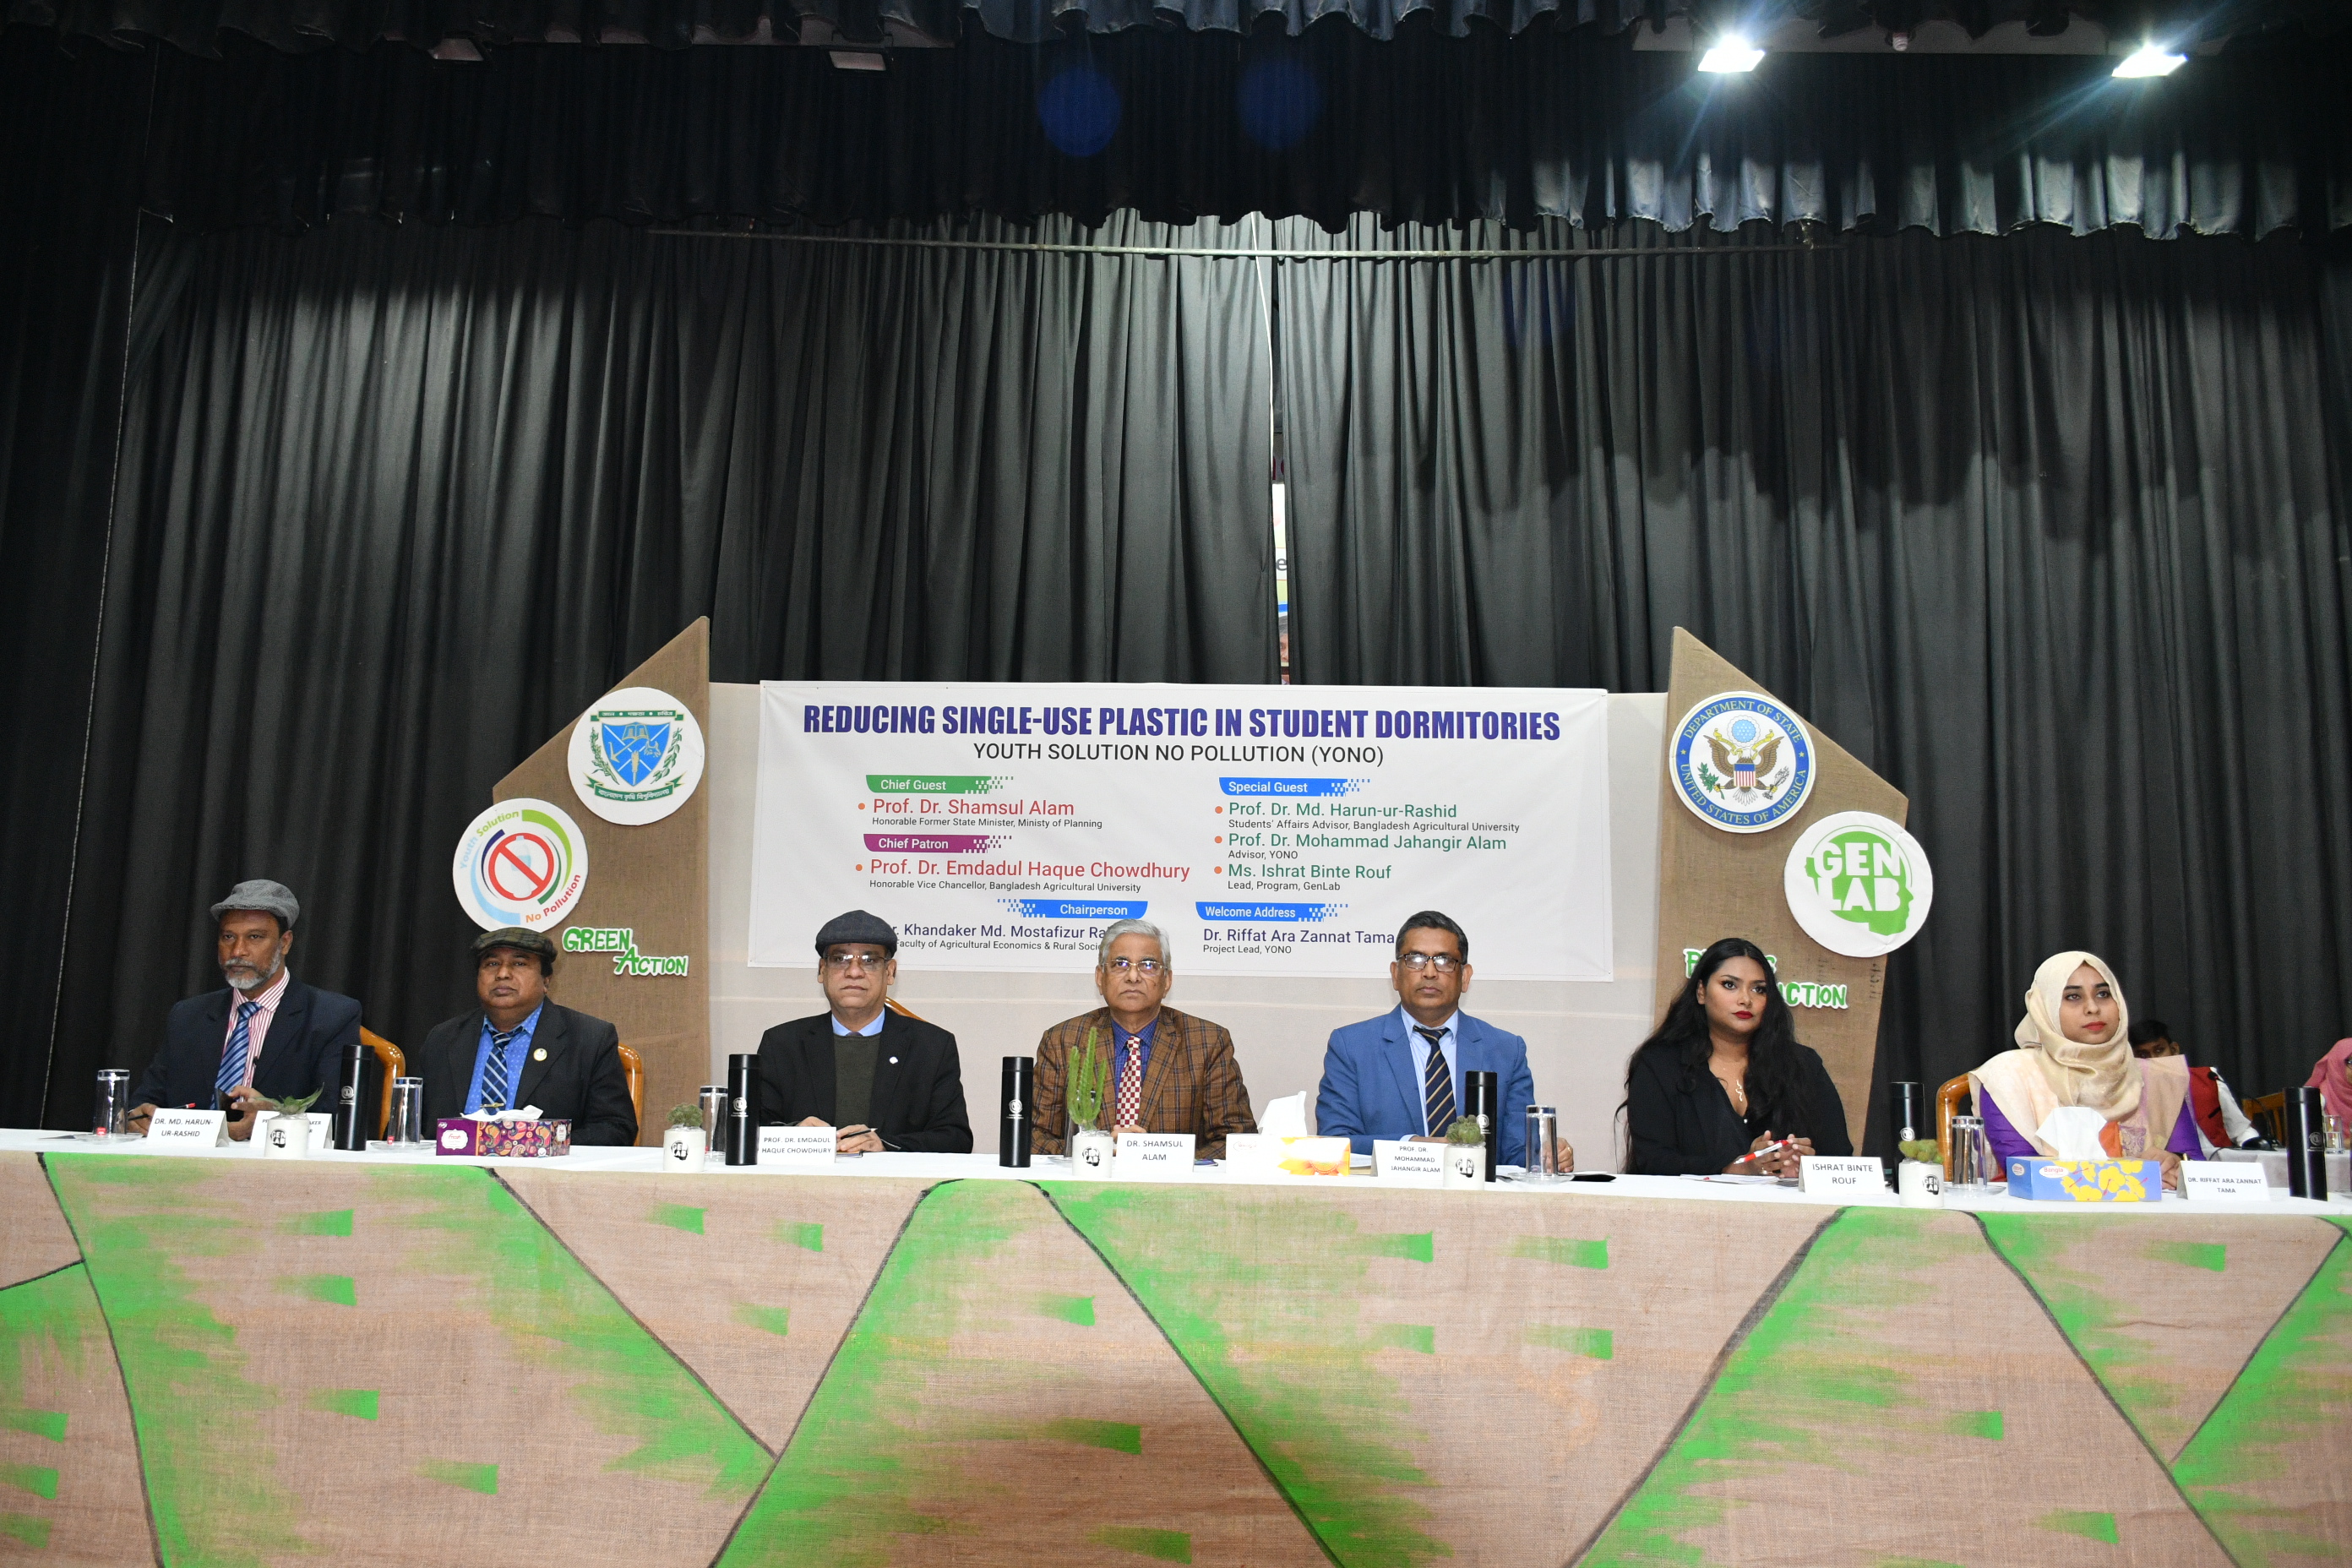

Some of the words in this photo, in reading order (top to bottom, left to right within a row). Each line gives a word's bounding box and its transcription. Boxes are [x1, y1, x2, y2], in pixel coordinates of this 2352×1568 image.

[804, 705, 935, 733] REDUCING
[942, 706, 1092, 735] SINGLE-USE
[1099, 707, 1207, 737] PLASTIC
[1215, 709, 1242, 737] IN
[1250, 709, 1368, 738] STUDENT
[1375, 710, 1560, 740] DORMITORIES
[1684, 700, 1755, 739] DEPARTMENT
[1757, 702, 1772, 716] OF
[1773, 710, 1804, 743] STATE
[973, 743, 1041, 759] YOUTH
[1048, 743, 1148, 760] SOLUTION
[1156, 745, 1184, 761] NO
[1191, 745, 1304, 762] POLLUTION
[1311, 745, 1384, 767] (YONO)
[880, 779, 911, 790] Chief
[913, 780, 946, 791] Guest
[1228, 781, 1271, 794] Special
[1273, 782, 1308, 792] Guest
[1680, 764, 1707, 811] UNITED
[1706, 803, 1750, 825] STATES
[1753, 811, 1769, 824] OF
[1772, 769, 1807, 819] AMERICA
[873, 798, 913, 814] Prof.
[920, 799, 941, 814] Dr.
[948, 799, 1023, 815] Shamsul
[1029, 800, 1074, 815] Alam
[1229, 802, 1265, 815] Prof.
[1271, 803, 1290, 815] Dr.
[1296, 803, 1324, 816] Md.
[1331, 803, 1457, 818] Harun-ur-Rashid
[872, 817, 917, 825] Honorable
[919, 818, 950, 826] Former
[953, 818, 976, 826] State
[978, 818, 1015, 828] Minister,
[1018, 818, 1049, 829] Ministy
[1052, 819, 1061, 827] of
[1064, 819, 1102, 830] Planning
[1277, 819, 1309, 829] Affairs
[1312, 820, 1350, 830] Advisor,
[1353, 821, 1409, 832] Bangladesh
[1413, 822, 1468, 832] Agricultural
[1472, 822, 1520, 833] University
[460, 836, 478, 869] Youth
[476, 810, 519, 837] Solution
[879, 838, 908, 848] Chief
[912, 839, 949, 849] Patron
[1228, 832, 1265, 847] Prof.
[1271, 833, 1290, 847] Dr.
[1297, 834, 1389, 848] Mohammad
[1394, 835, 1462, 852] Jahangir
[1467, 836, 1506, 849] Alam
[1228, 850, 1266, 859] Advisor,
[1269, 851, 1298, 859] YONO
[1814, 841, 1903, 879] GEN
[871, 858, 911, 874] Prof.
[918, 860, 939, 874] Dr.
[946, 860, 1022, 875] Emdadul
[1028, 861, 1085, 880] Haque
[1091, 862, 1190, 882] Chowdhury
[1228, 863, 1255, 877] Ms.
[1262, 863, 1305, 878] Ishrat
[1311, 864, 1350, 878] Binte
[1355, 865, 1391, 879] Rouf
[869, 880, 914, 889] Honorable
[917, 880, 936, 889] Vice
[939, 880, 987, 890] Chancellor,
[989, 881, 1040, 892] Bangladesh
[1043, 882, 1094, 892] Agricultural
[1097, 883, 1141, 893] University
[1228, 880, 1254, 890] Lead,
[1256, 881, 1300, 891] Program,
[1304, 881, 1340, 890] GenLab
[525, 912, 542, 923] No
[543, 874, 581, 917] Pollution
[1818, 877, 1901, 912] LAB
[1060, 904, 1128, 917] Chairperson
[1205, 906, 1251, 917] Welcome
[1254, 906, 1295, 917] Address
[904, 923, 977, 936] Khandaker
[981, 925, 1005, 937] Md.
[1010, 926, 1085, 938] Mostafizur
[1204, 928, 1222, 941] Dr.
[1228, 928, 1266, 942] Riffat
[1271, 929, 1295, 942] Ara
[1300, 930, 1351, 943] Zannat
[1355, 931, 1395, 943] Tama
[564, 928, 631, 951] GREEN
[928, 939, 937, 948] of
[939, 940, 990, 950] Agricultural
[994, 941, 1042, 950] Economics
[1054, 942, 1075, 950] Rural
[1203, 945, 1235, 955] Project
[1238, 945, 1261, 955] Lead,
[1265, 945, 1292, 954] YONO
[616, 947, 687, 974] ACTION
